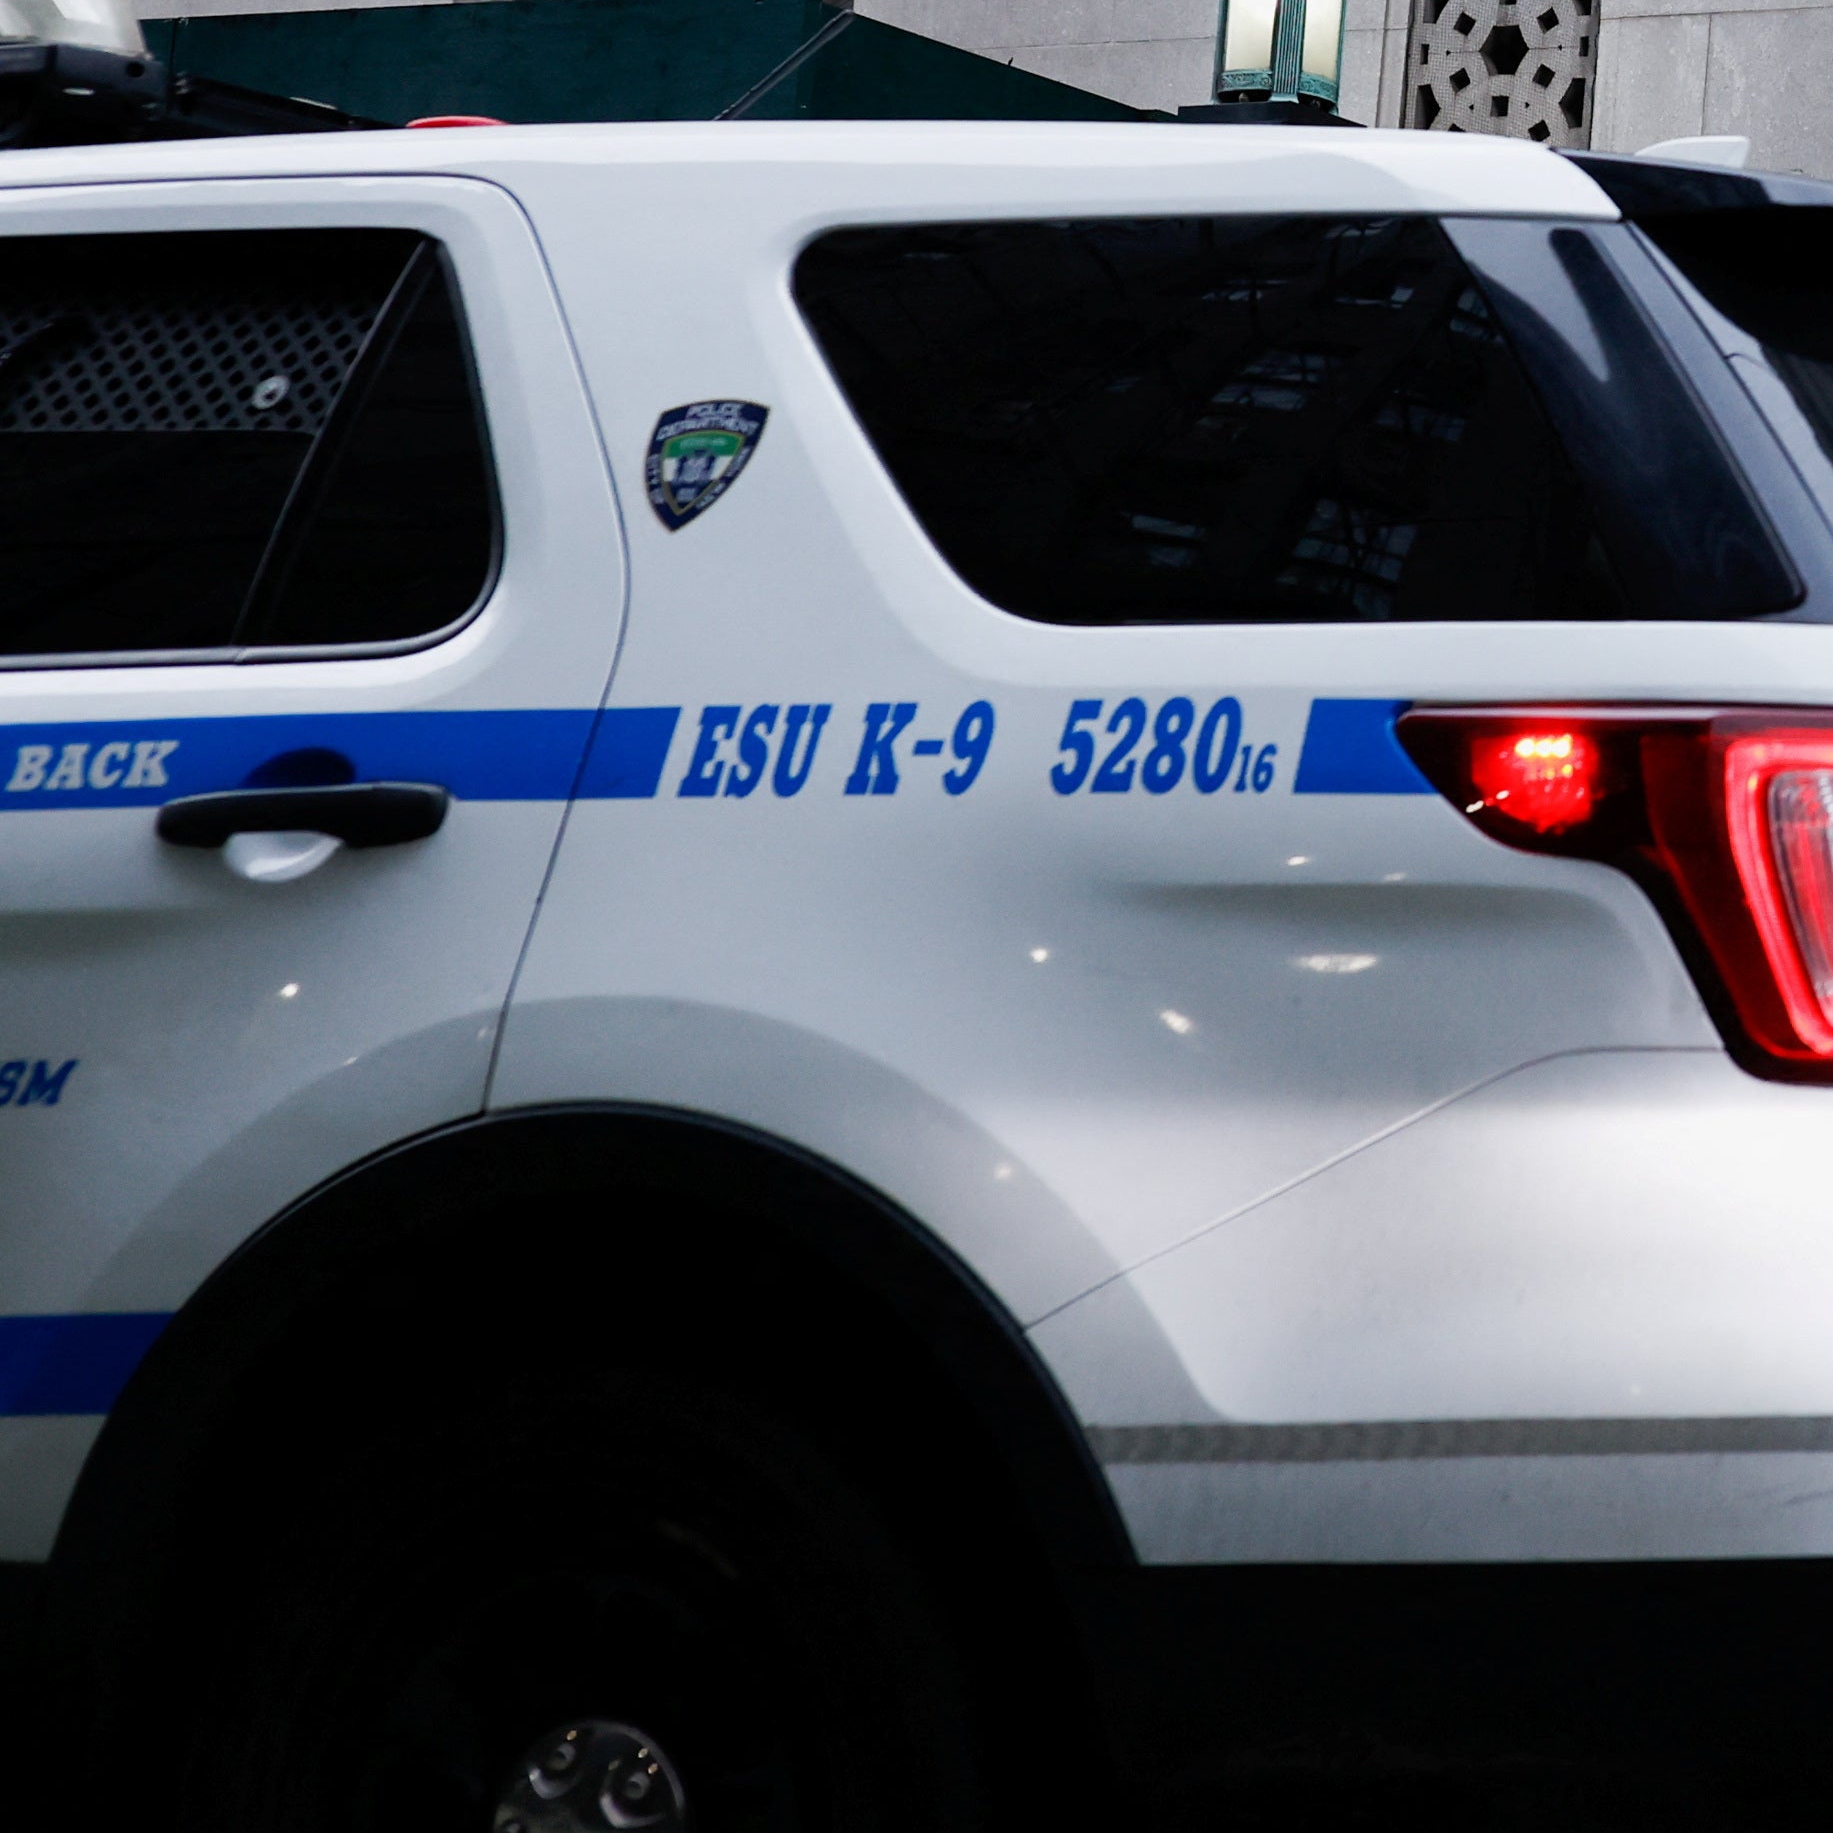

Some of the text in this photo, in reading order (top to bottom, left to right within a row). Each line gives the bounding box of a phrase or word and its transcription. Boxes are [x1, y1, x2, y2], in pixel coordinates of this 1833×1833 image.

[6, 740, 180, 793] BACK
[676, 703, 832, 799] ESU
[842, 699, 997, 797] K-9
